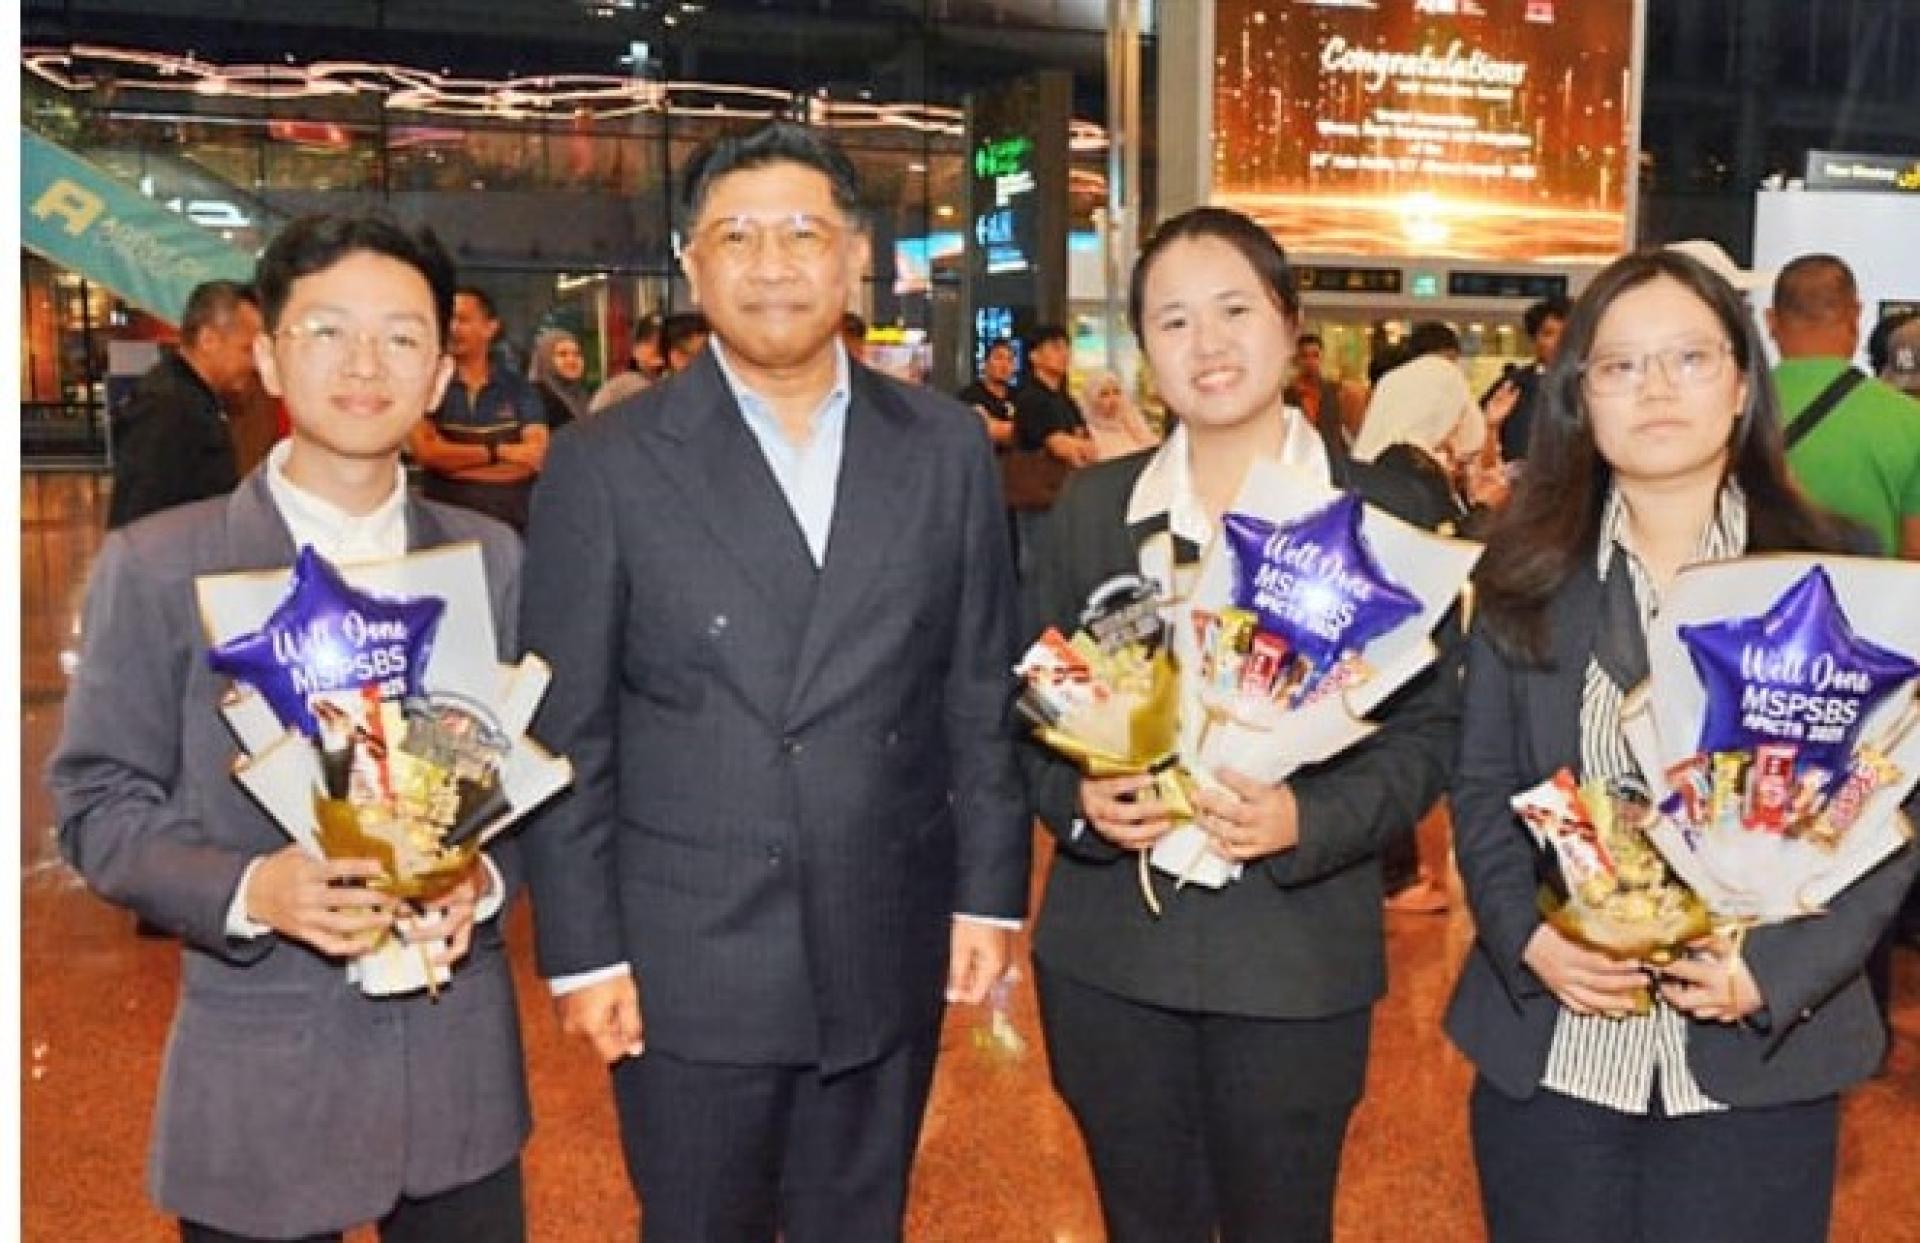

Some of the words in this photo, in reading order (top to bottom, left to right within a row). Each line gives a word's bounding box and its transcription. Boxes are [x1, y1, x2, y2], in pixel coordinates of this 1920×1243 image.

[1319, 36, 1529, 93] Congratulations
[1263, 533, 1321, 573] Well
[342, 609, 408, 648] Done
[1741, 641, 1804, 684] Well
[1811, 652, 1872, 692] Done
[1741, 685, 1860, 724] MSPSBS
